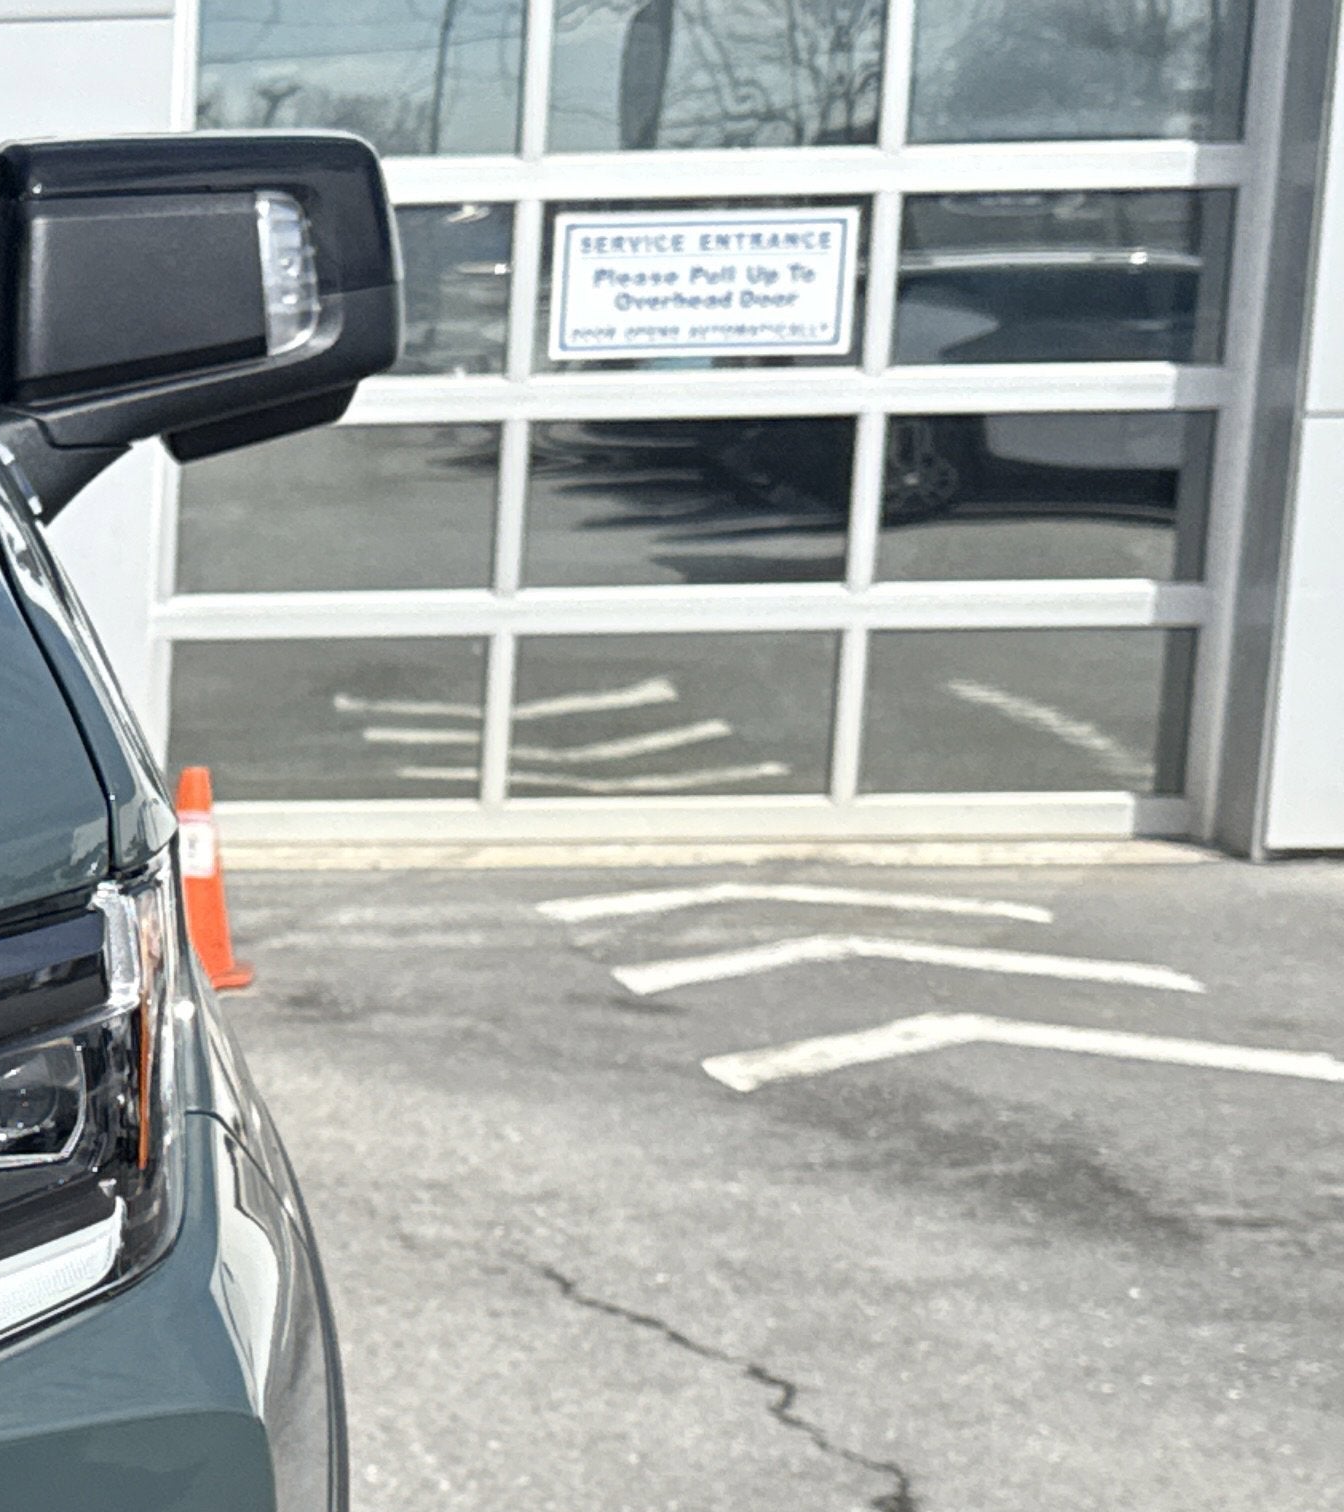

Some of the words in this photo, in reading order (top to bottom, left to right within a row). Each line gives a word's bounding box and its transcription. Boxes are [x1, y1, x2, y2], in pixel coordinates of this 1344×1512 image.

[581, 234, 685, 254] SERVICE
[699, 231, 831, 251] ENTRANCE
[593, 267, 679, 288] Please
[689, 265, 736, 285] Pull
[746, 264, 779, 287] Up
[788, 262, 816, 283] To
[614, 289, 733, 311] Overhead
[739, 290, 800, 309] Door
